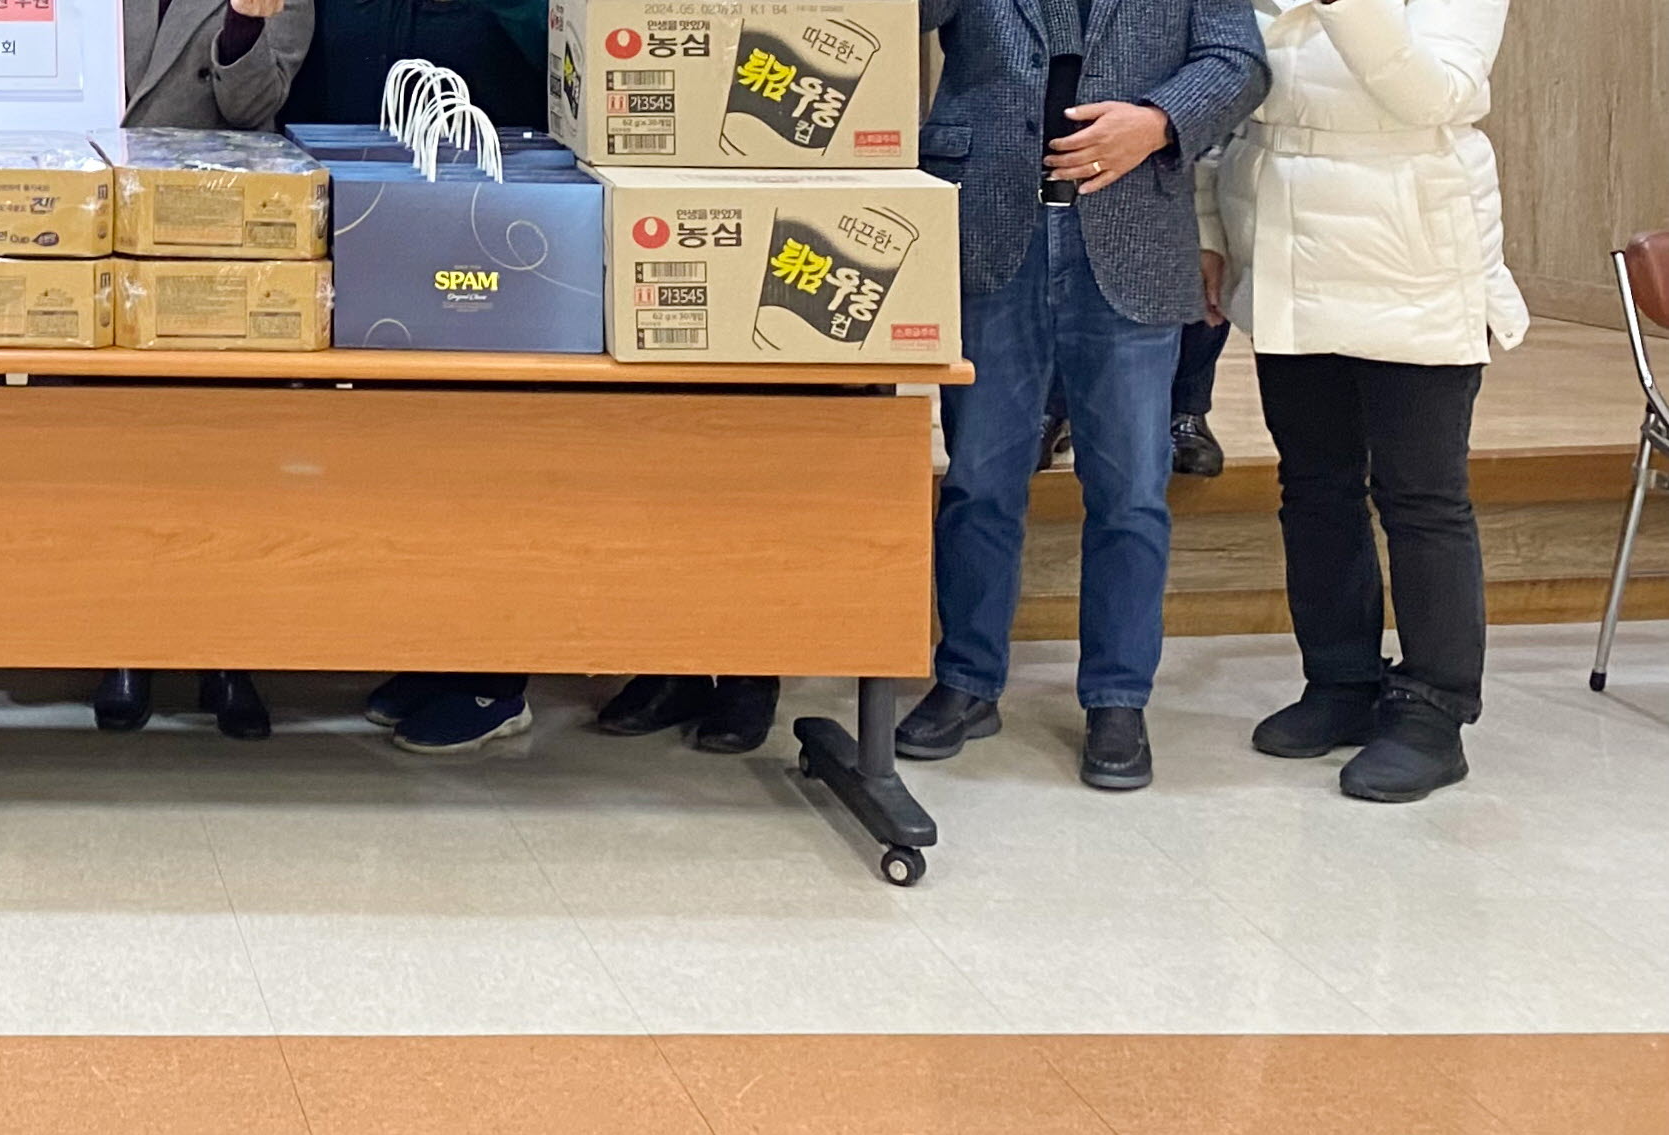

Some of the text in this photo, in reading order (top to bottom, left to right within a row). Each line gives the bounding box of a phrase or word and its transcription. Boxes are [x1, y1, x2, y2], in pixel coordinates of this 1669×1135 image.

[647, 20, 710, 31] 인생을 맛있게
[647, 33, 710, 58] 농심
[630, 96, 672, 111] 가3545
[794, 119, 815, 144] 컵
[677, 209, 742, 220] 인생을 맛있게
[677, 222, 742, 248] 농심
[434, 270, 499, 291] SPAM
[660, 288, 705, 304] 가3545
[830, 313, 852, 338] 컵
